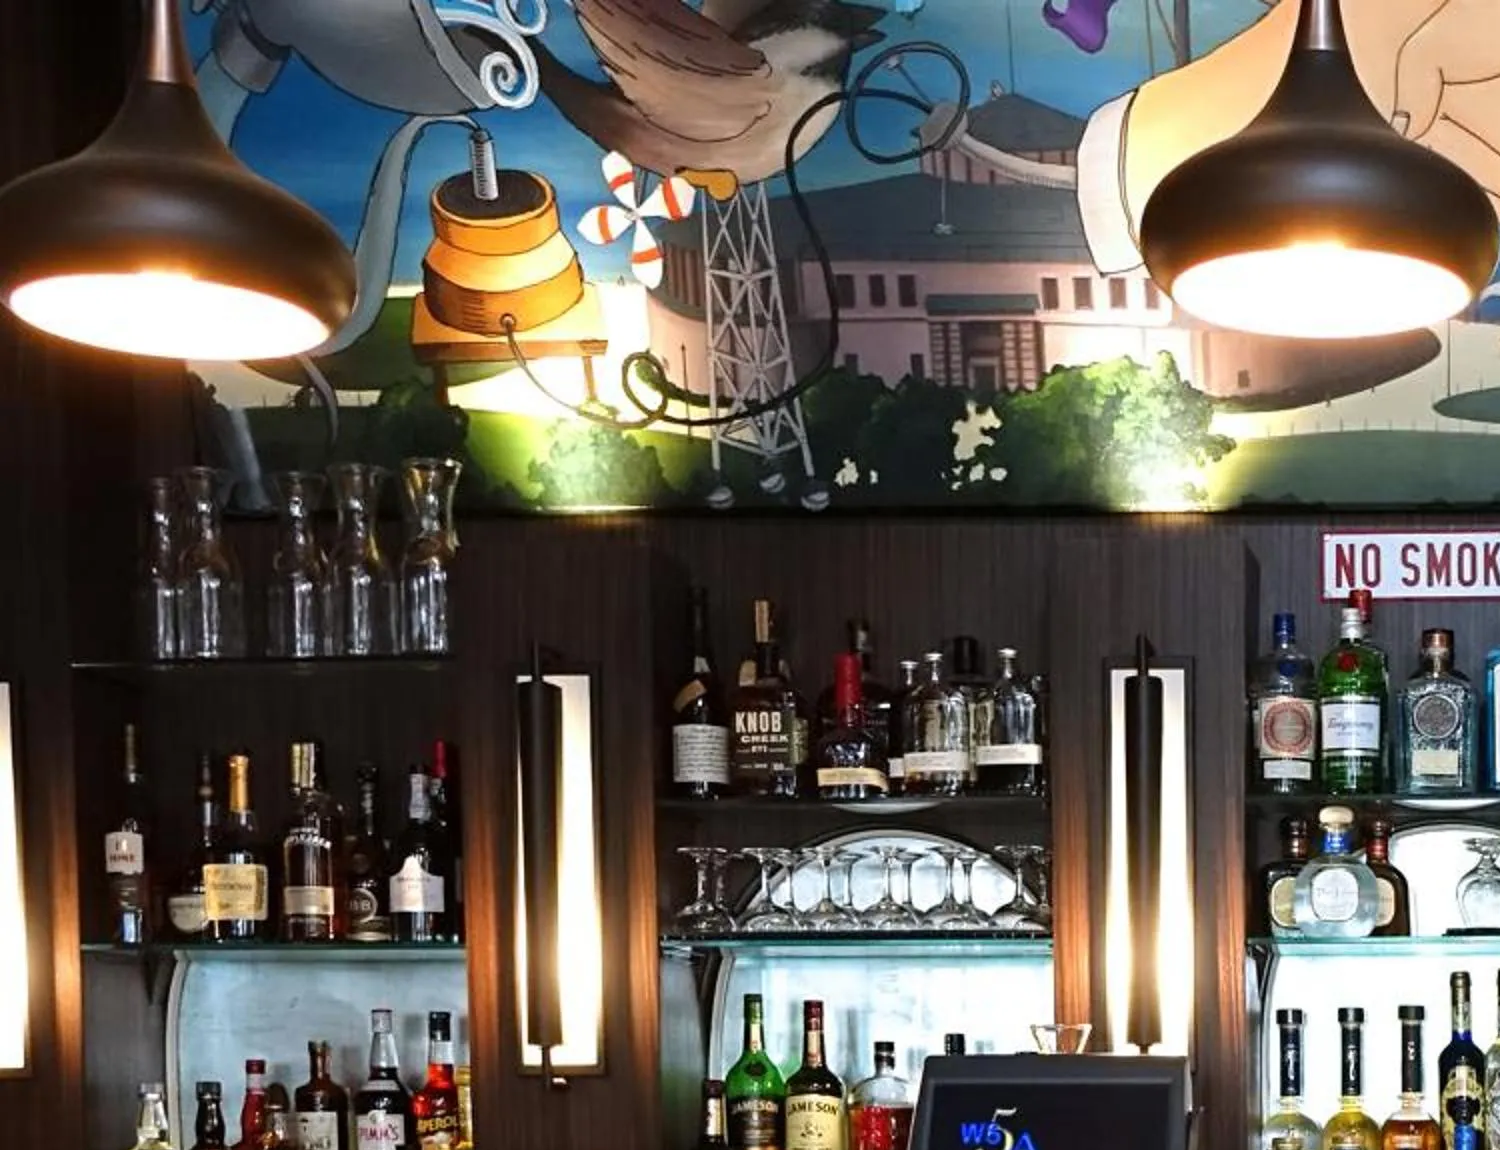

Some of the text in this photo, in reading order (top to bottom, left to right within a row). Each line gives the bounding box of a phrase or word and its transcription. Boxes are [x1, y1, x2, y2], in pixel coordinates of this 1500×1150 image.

[1335, 543, 1382, 589] NO
[735, 711, 782, 733] KNOB
[740, 735, 789, 743] CREEK
[731, 1100, 779, 1114] JAMESON
[788, 1101, 839, 1116] JAMESON
[417, 1115, 456, 1134] APEROL
